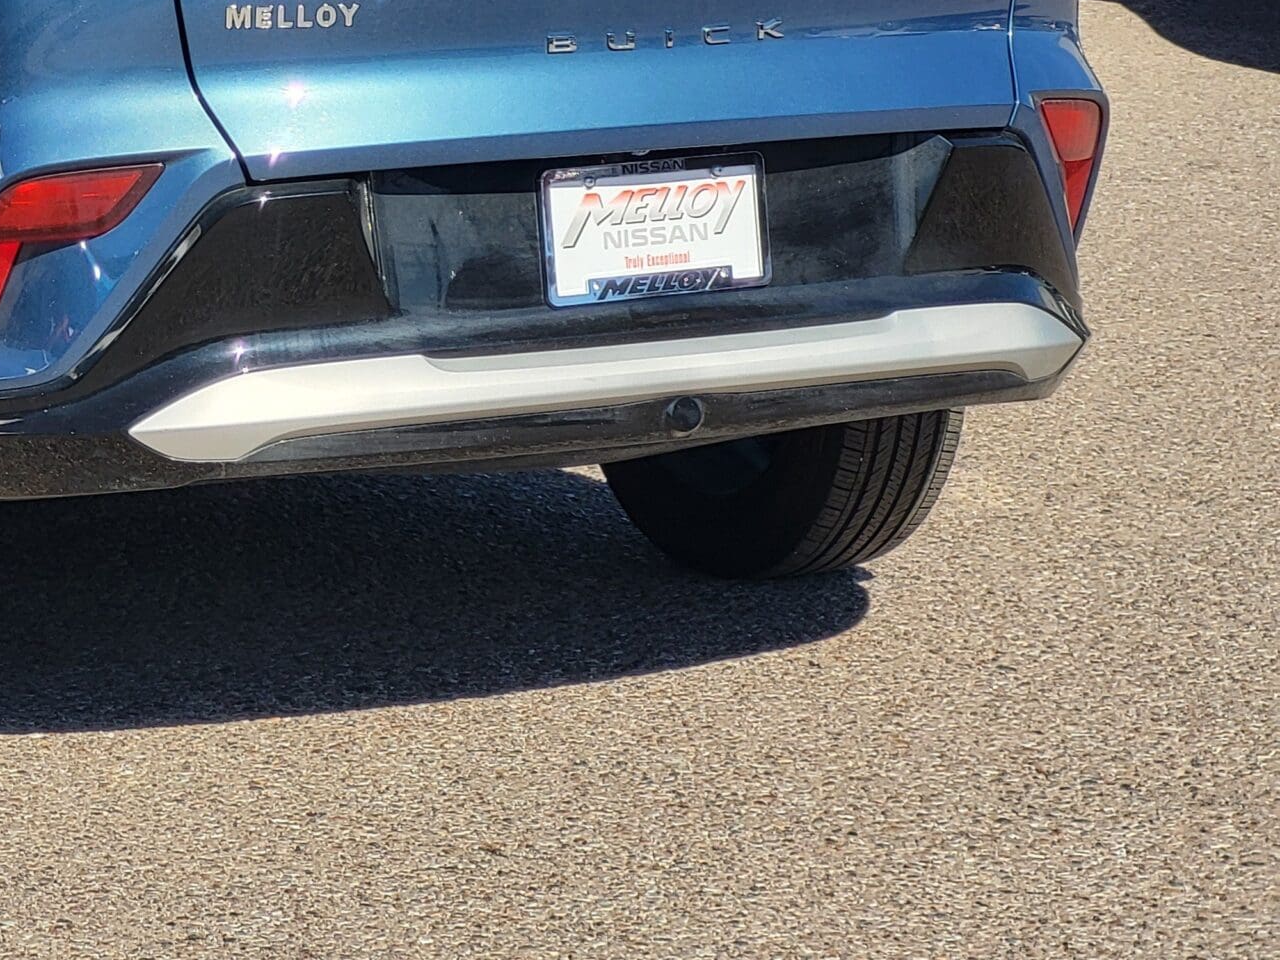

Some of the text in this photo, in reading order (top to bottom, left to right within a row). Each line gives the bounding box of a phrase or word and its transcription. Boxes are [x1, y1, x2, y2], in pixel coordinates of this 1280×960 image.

[225, 2, 360, 30] MELLOY
[547, 17, 785, 54] BUICK
[621, 159, 687, 176] NISSAN
[562, 180, 746, 249] MELLOY
[603, 222, 709, 250] NISSAN
[624, 251, 691, 271] Truly Exceptional
[596, 267, 721, 301] MELLOY
